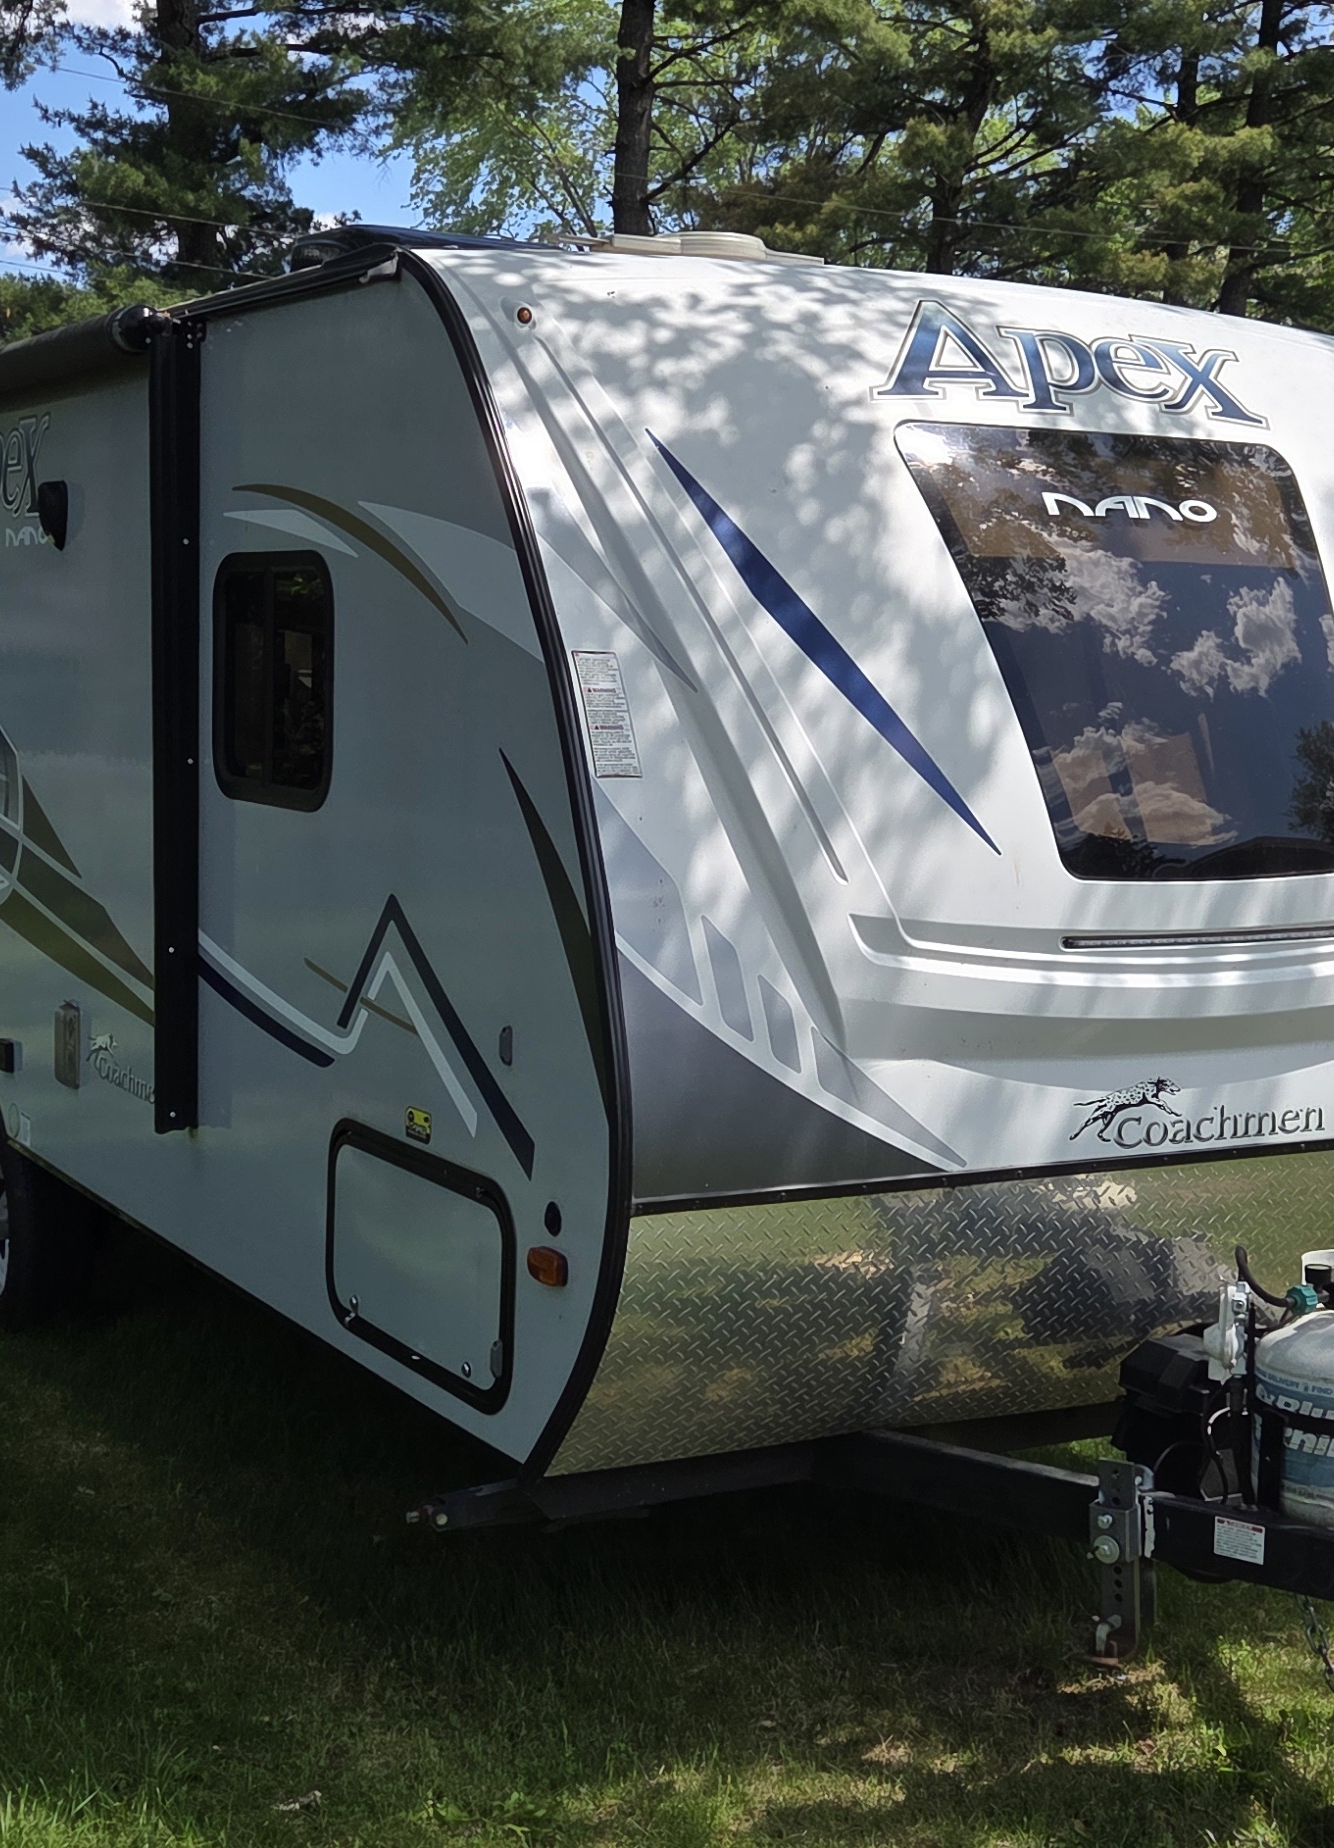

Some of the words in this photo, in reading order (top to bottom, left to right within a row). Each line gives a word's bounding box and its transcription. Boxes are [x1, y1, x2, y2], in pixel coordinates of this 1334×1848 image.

[869, 299, 1272, 431] Apex
[94, 1050, 156, 1104] Coachme
[1113, 1105, 1325, 1149] Coachmen
[1312, 1385, 1333, 1396] FIND
